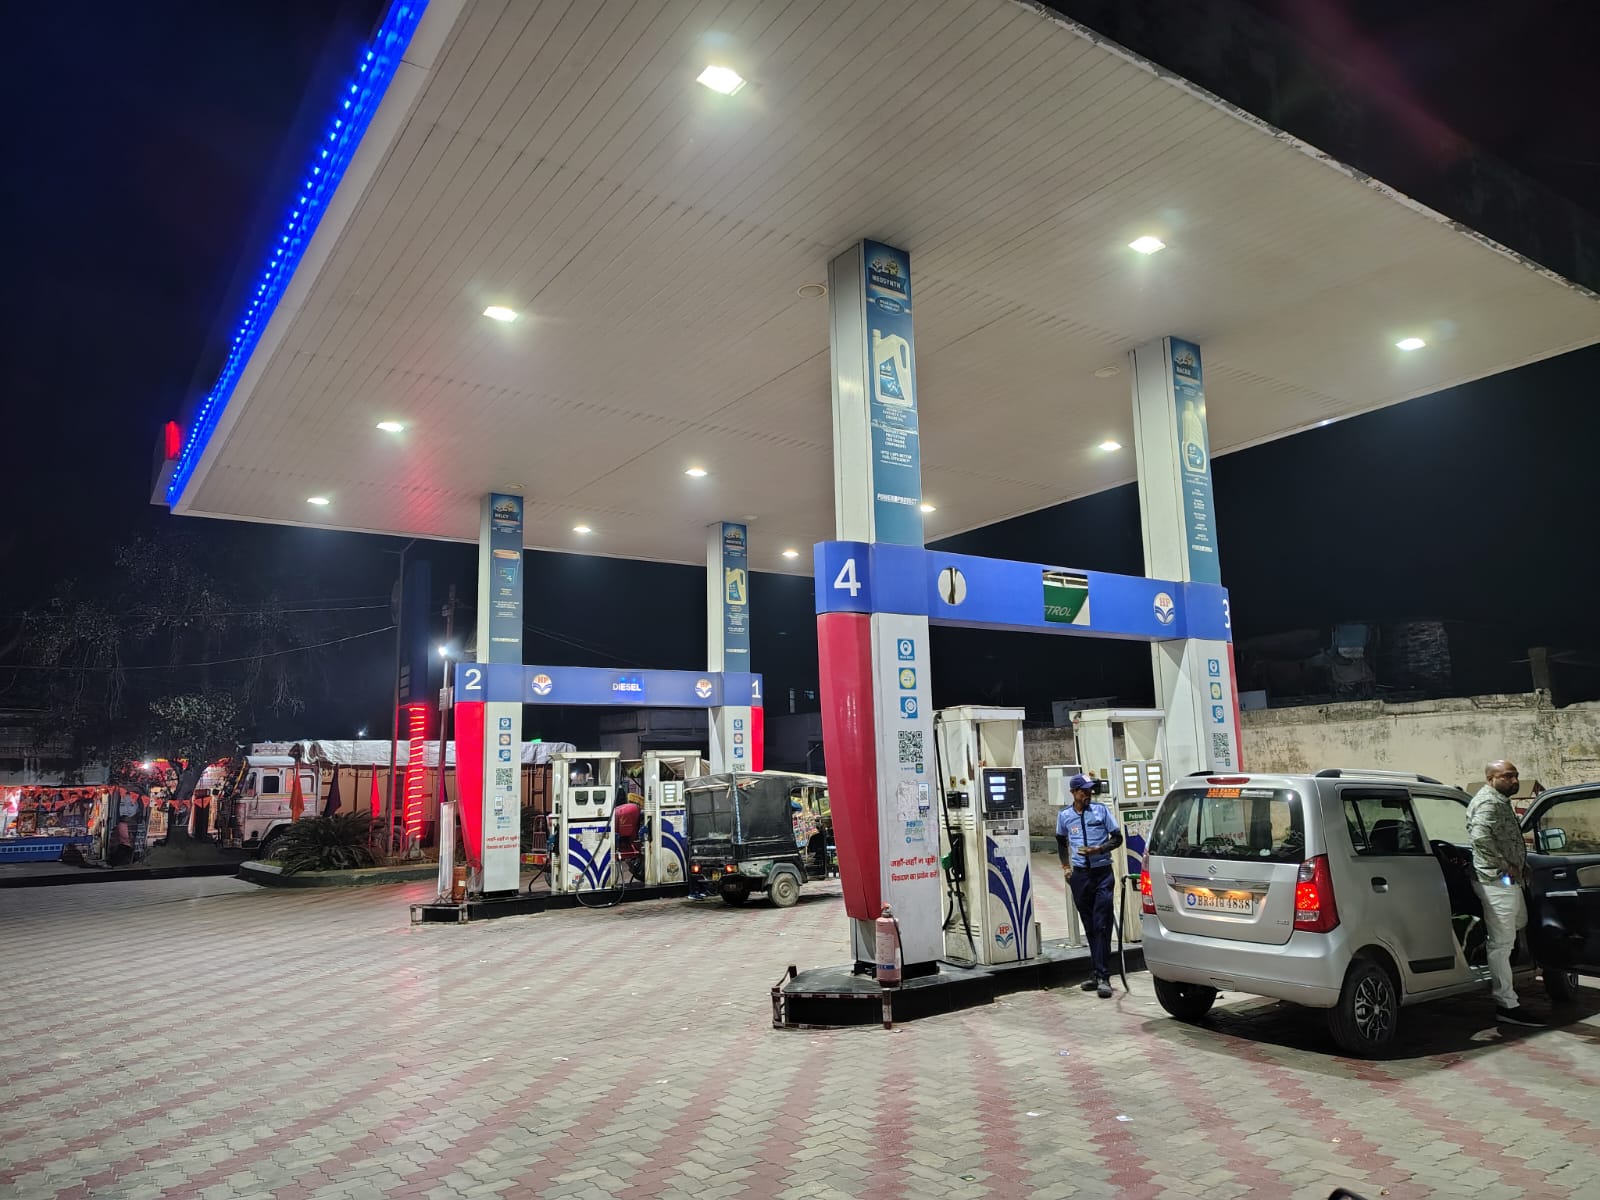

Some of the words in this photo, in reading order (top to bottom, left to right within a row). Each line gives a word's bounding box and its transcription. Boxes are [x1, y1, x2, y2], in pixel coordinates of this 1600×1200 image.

[834, 558, 862, 597] 4
[1159, 597, 1171, 607] HP
[1222, 598, 1231, 629] 3
[465, 668, 482, 690] 2
[612, 683, 643, 692] DIESEL
[752, 680, 762, 699] 1
[999, 926, 1010, 935] HP
